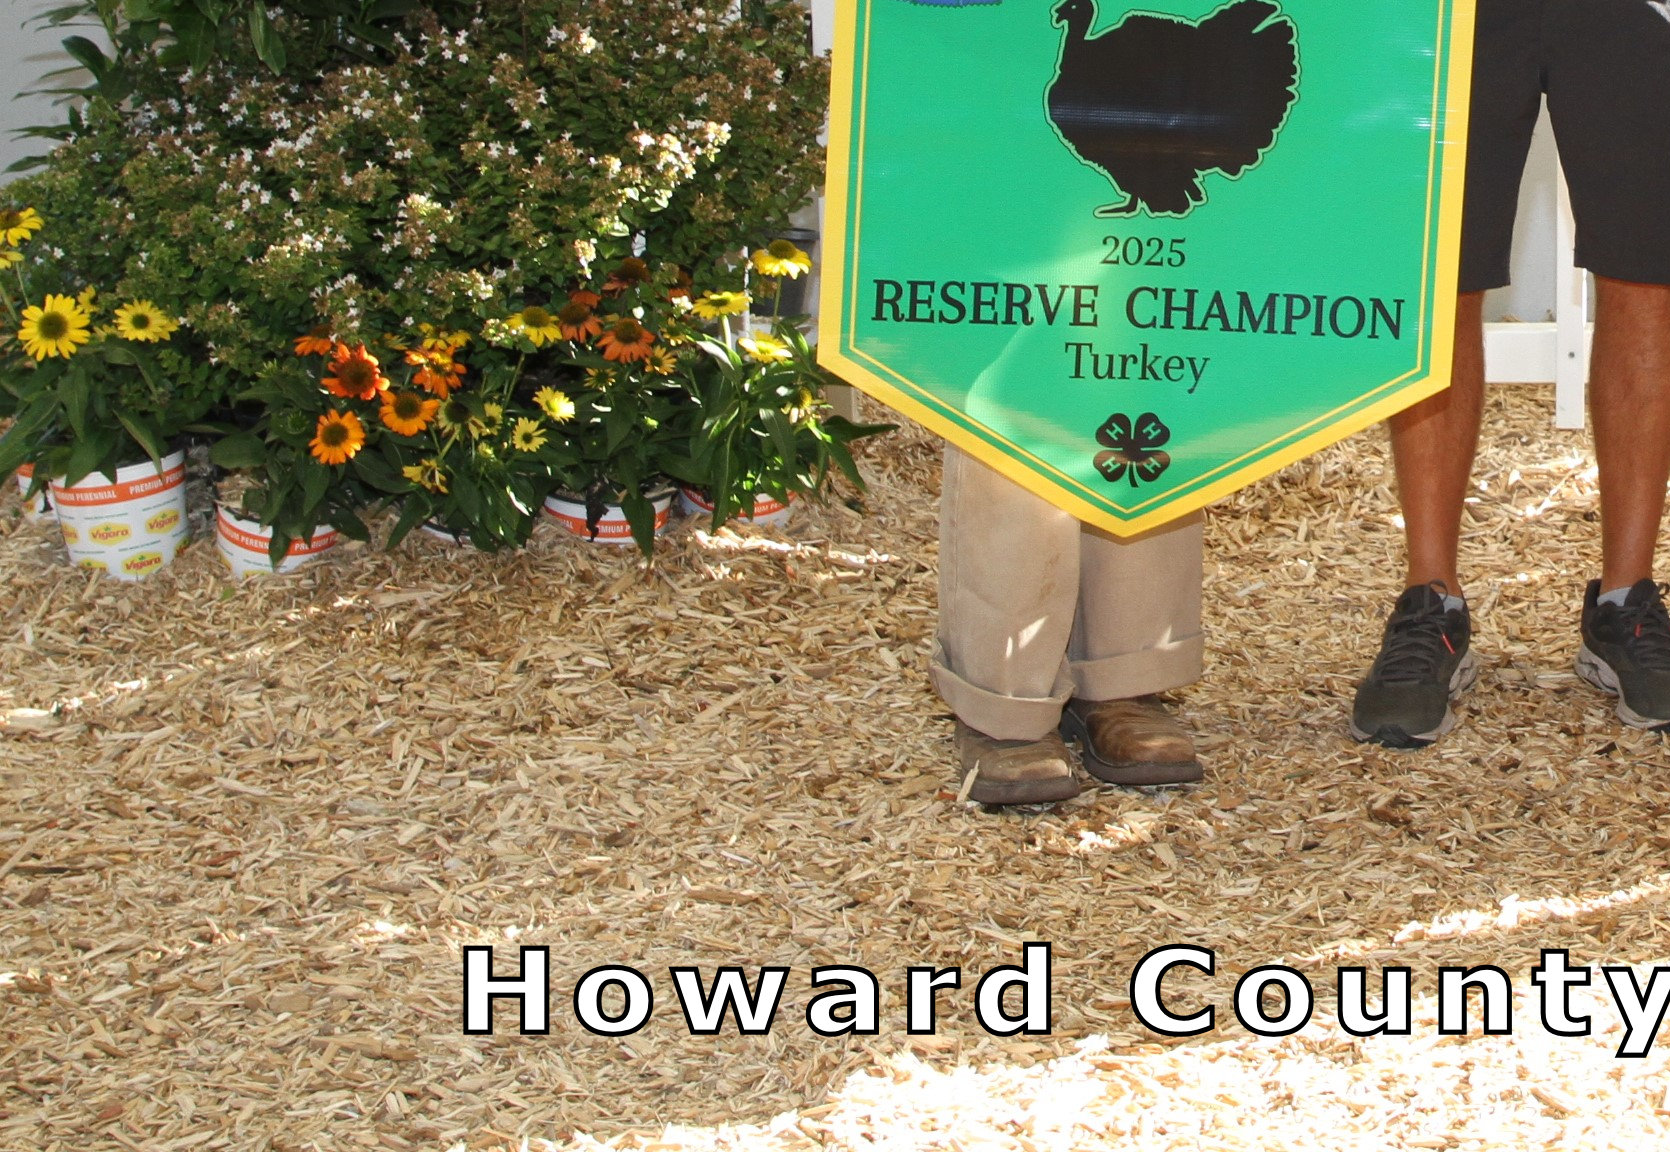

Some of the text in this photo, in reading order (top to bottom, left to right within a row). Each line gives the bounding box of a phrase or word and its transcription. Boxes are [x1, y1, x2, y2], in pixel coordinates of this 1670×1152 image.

[1101, 235, 1186, 268] 2025
[871, 278, 1405, 341] RESERVE CHAMPION
[1065, 342, 1210, 395] Turkey
[76, 490, 117, 501] PERENNIAL
[129, 478, 163, 495] PREMIUM
[91, 529, 129, 540] Vigoro
[147, 514, 179, 532] Vigoro
[126, 556, 161, 571] Vigoro
